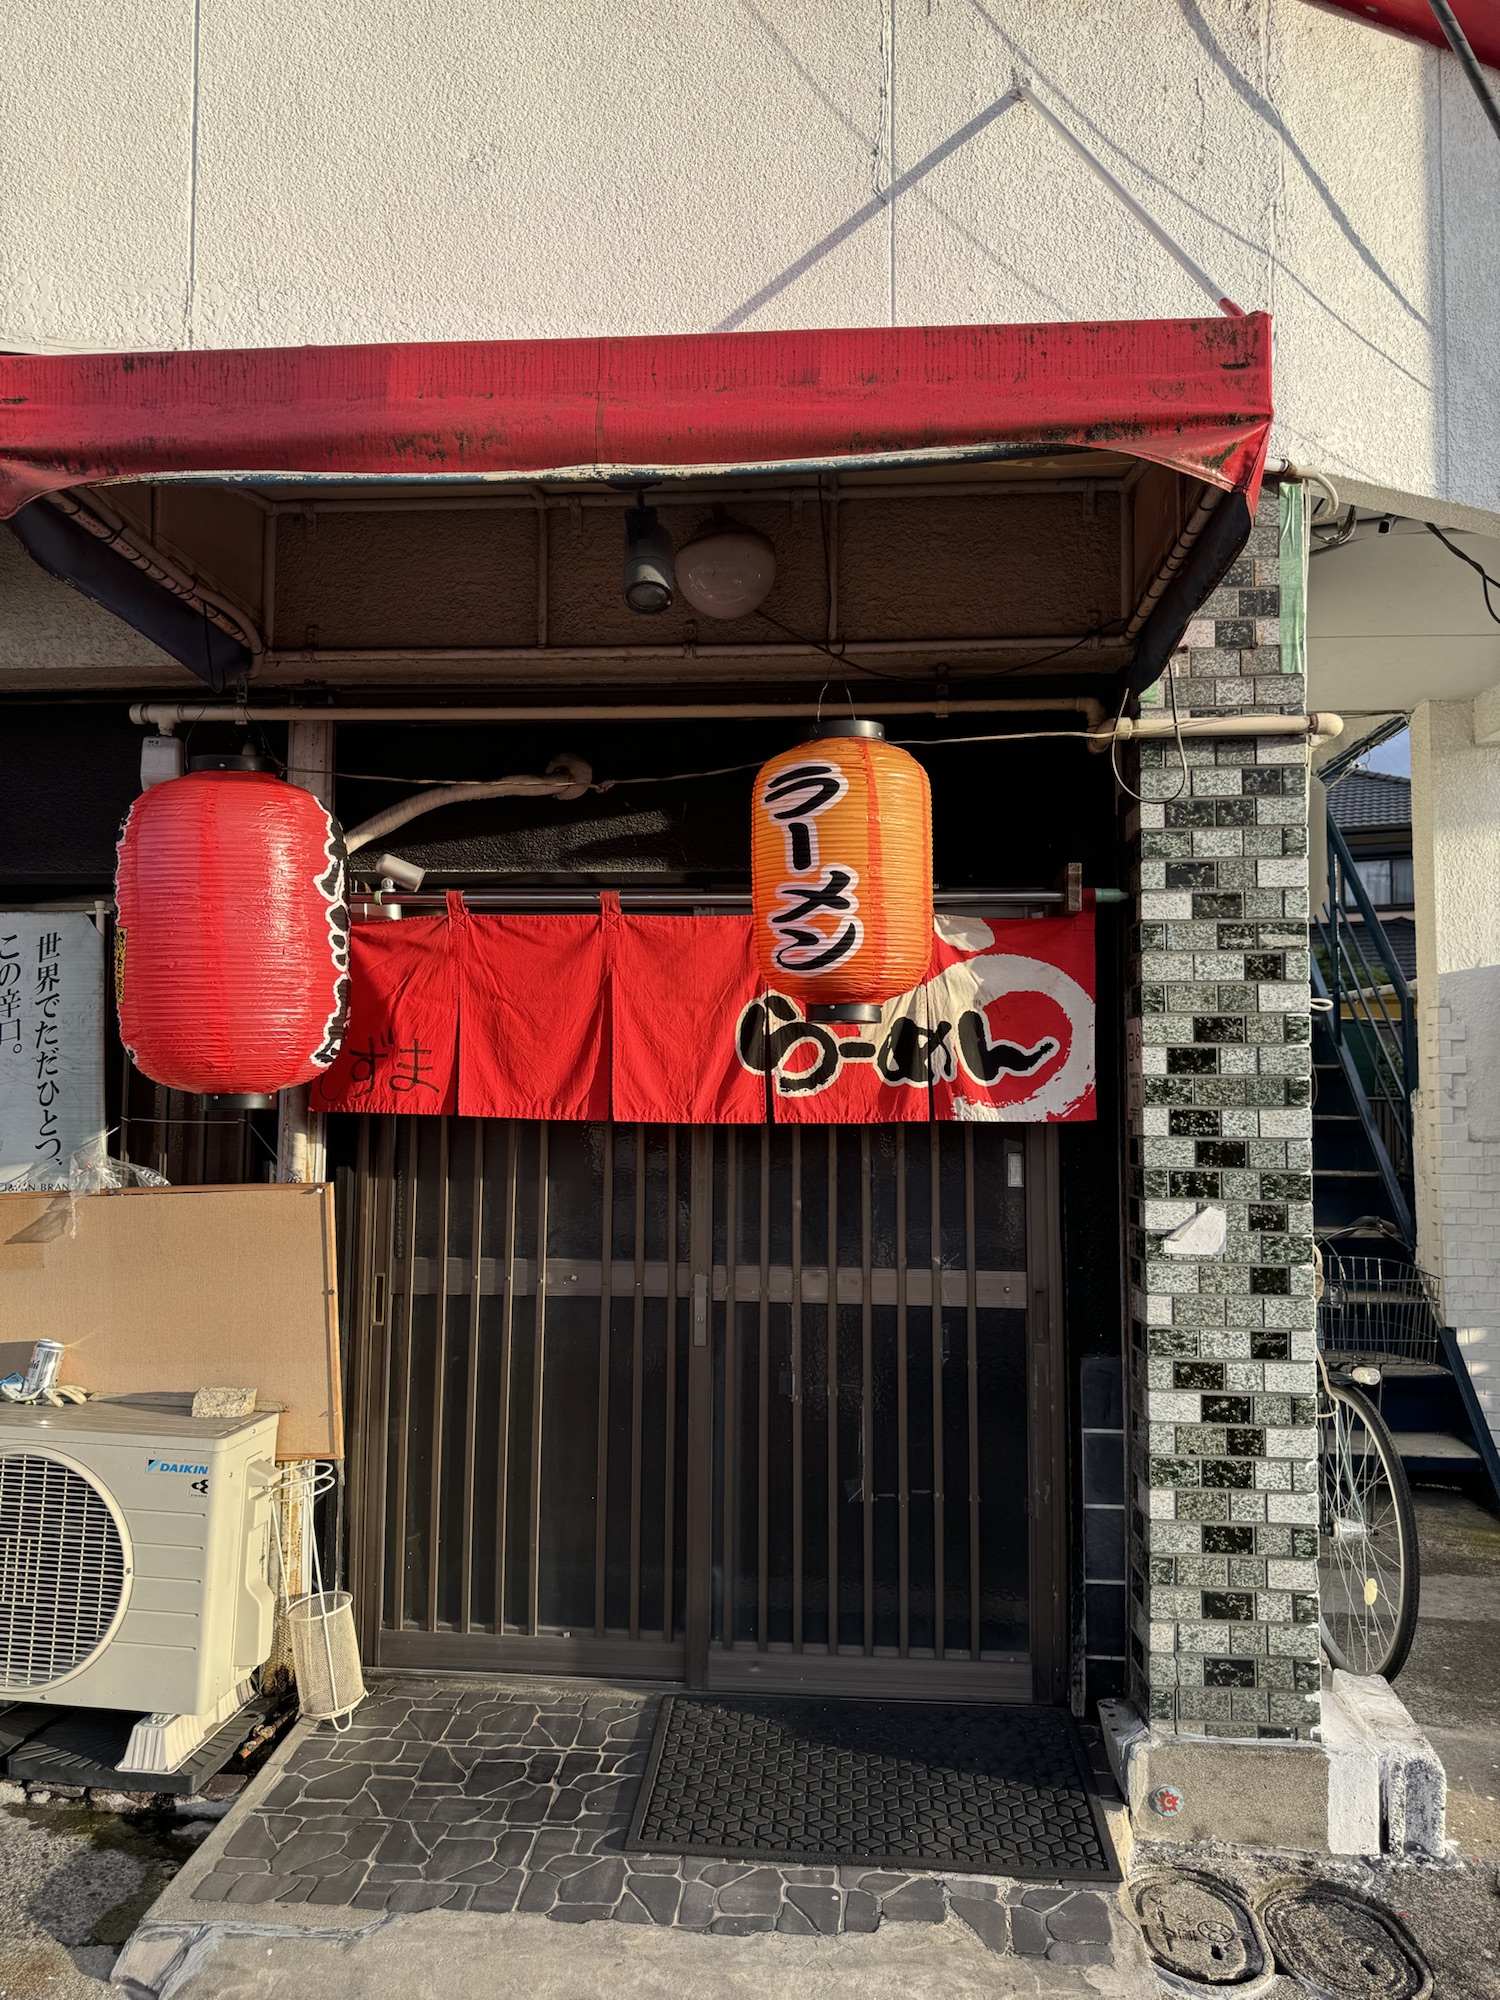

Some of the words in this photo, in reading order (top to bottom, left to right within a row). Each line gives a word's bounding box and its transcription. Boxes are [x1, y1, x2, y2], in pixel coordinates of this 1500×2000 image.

[764, 765, 857, 971] ラーメン
[0, 934, 23, 1054] この辛口。
[739, 995, 1055, 1093] らーめん
[159, 1463, 209, 1475] DAIKIN
